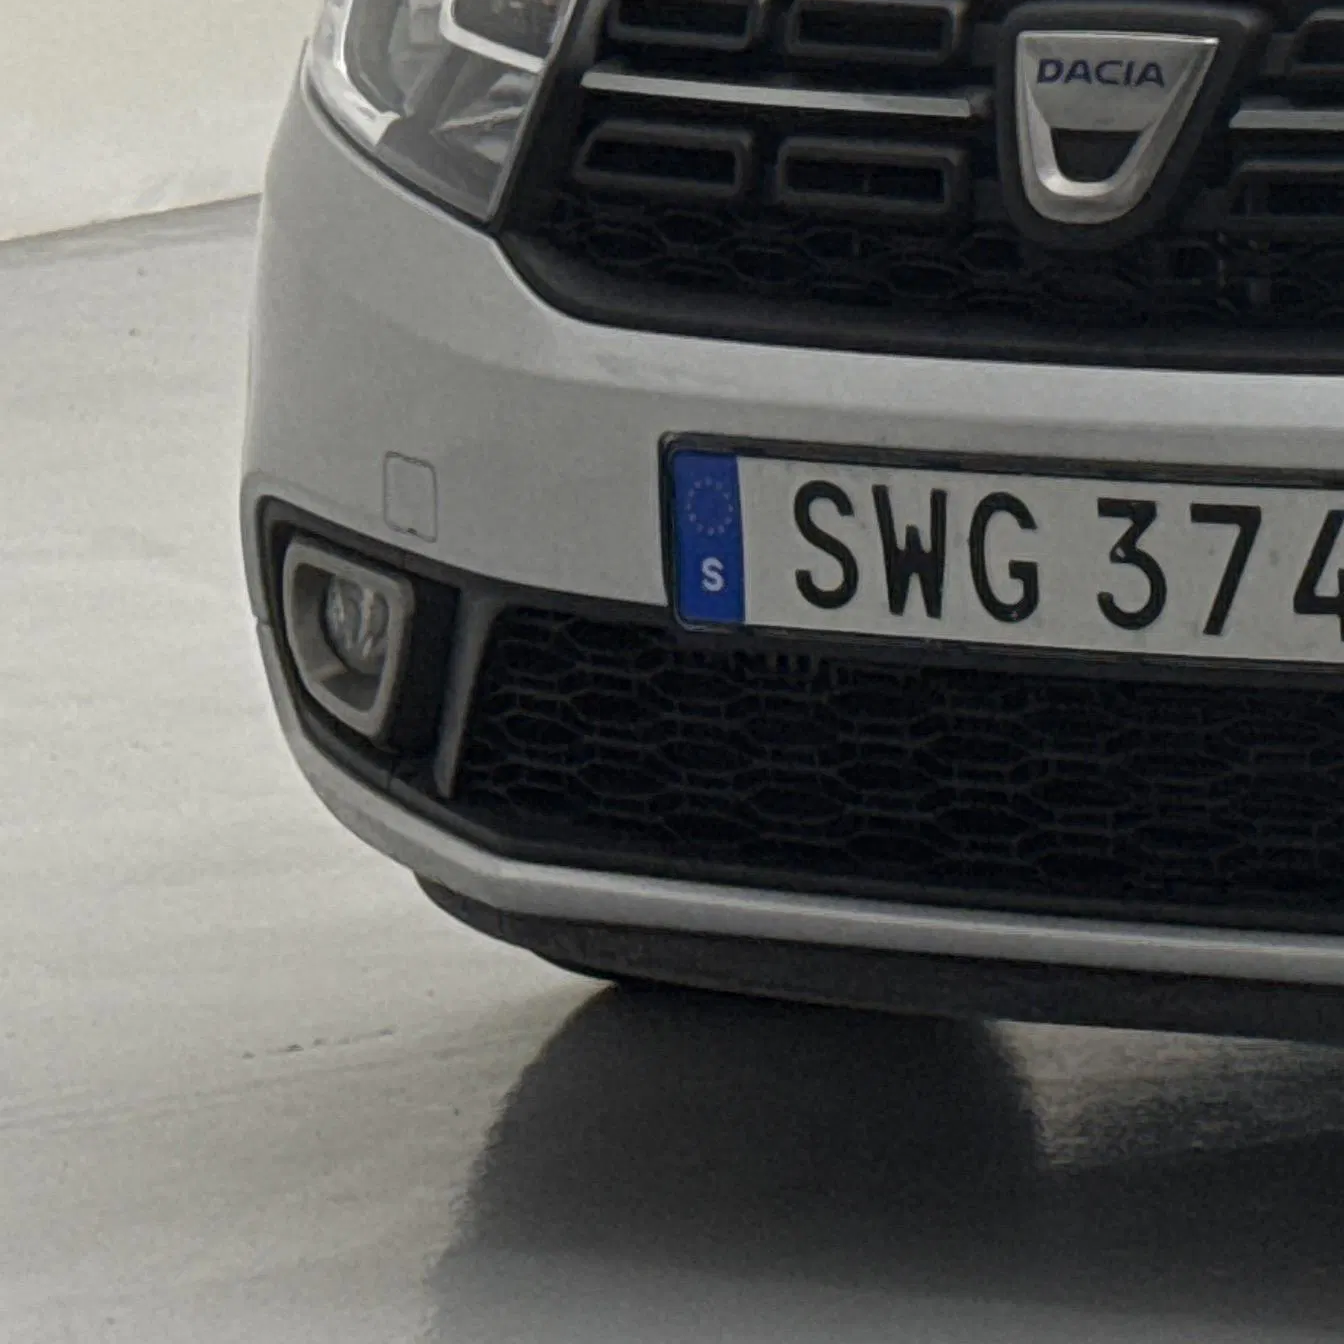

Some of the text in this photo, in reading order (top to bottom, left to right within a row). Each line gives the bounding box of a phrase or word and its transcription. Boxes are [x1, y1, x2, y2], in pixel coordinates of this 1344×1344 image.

[1037, 58, 1165, 88] DACIA
[794, 480, 1040, 622] SWG
[702, 557, 724, 591] S
